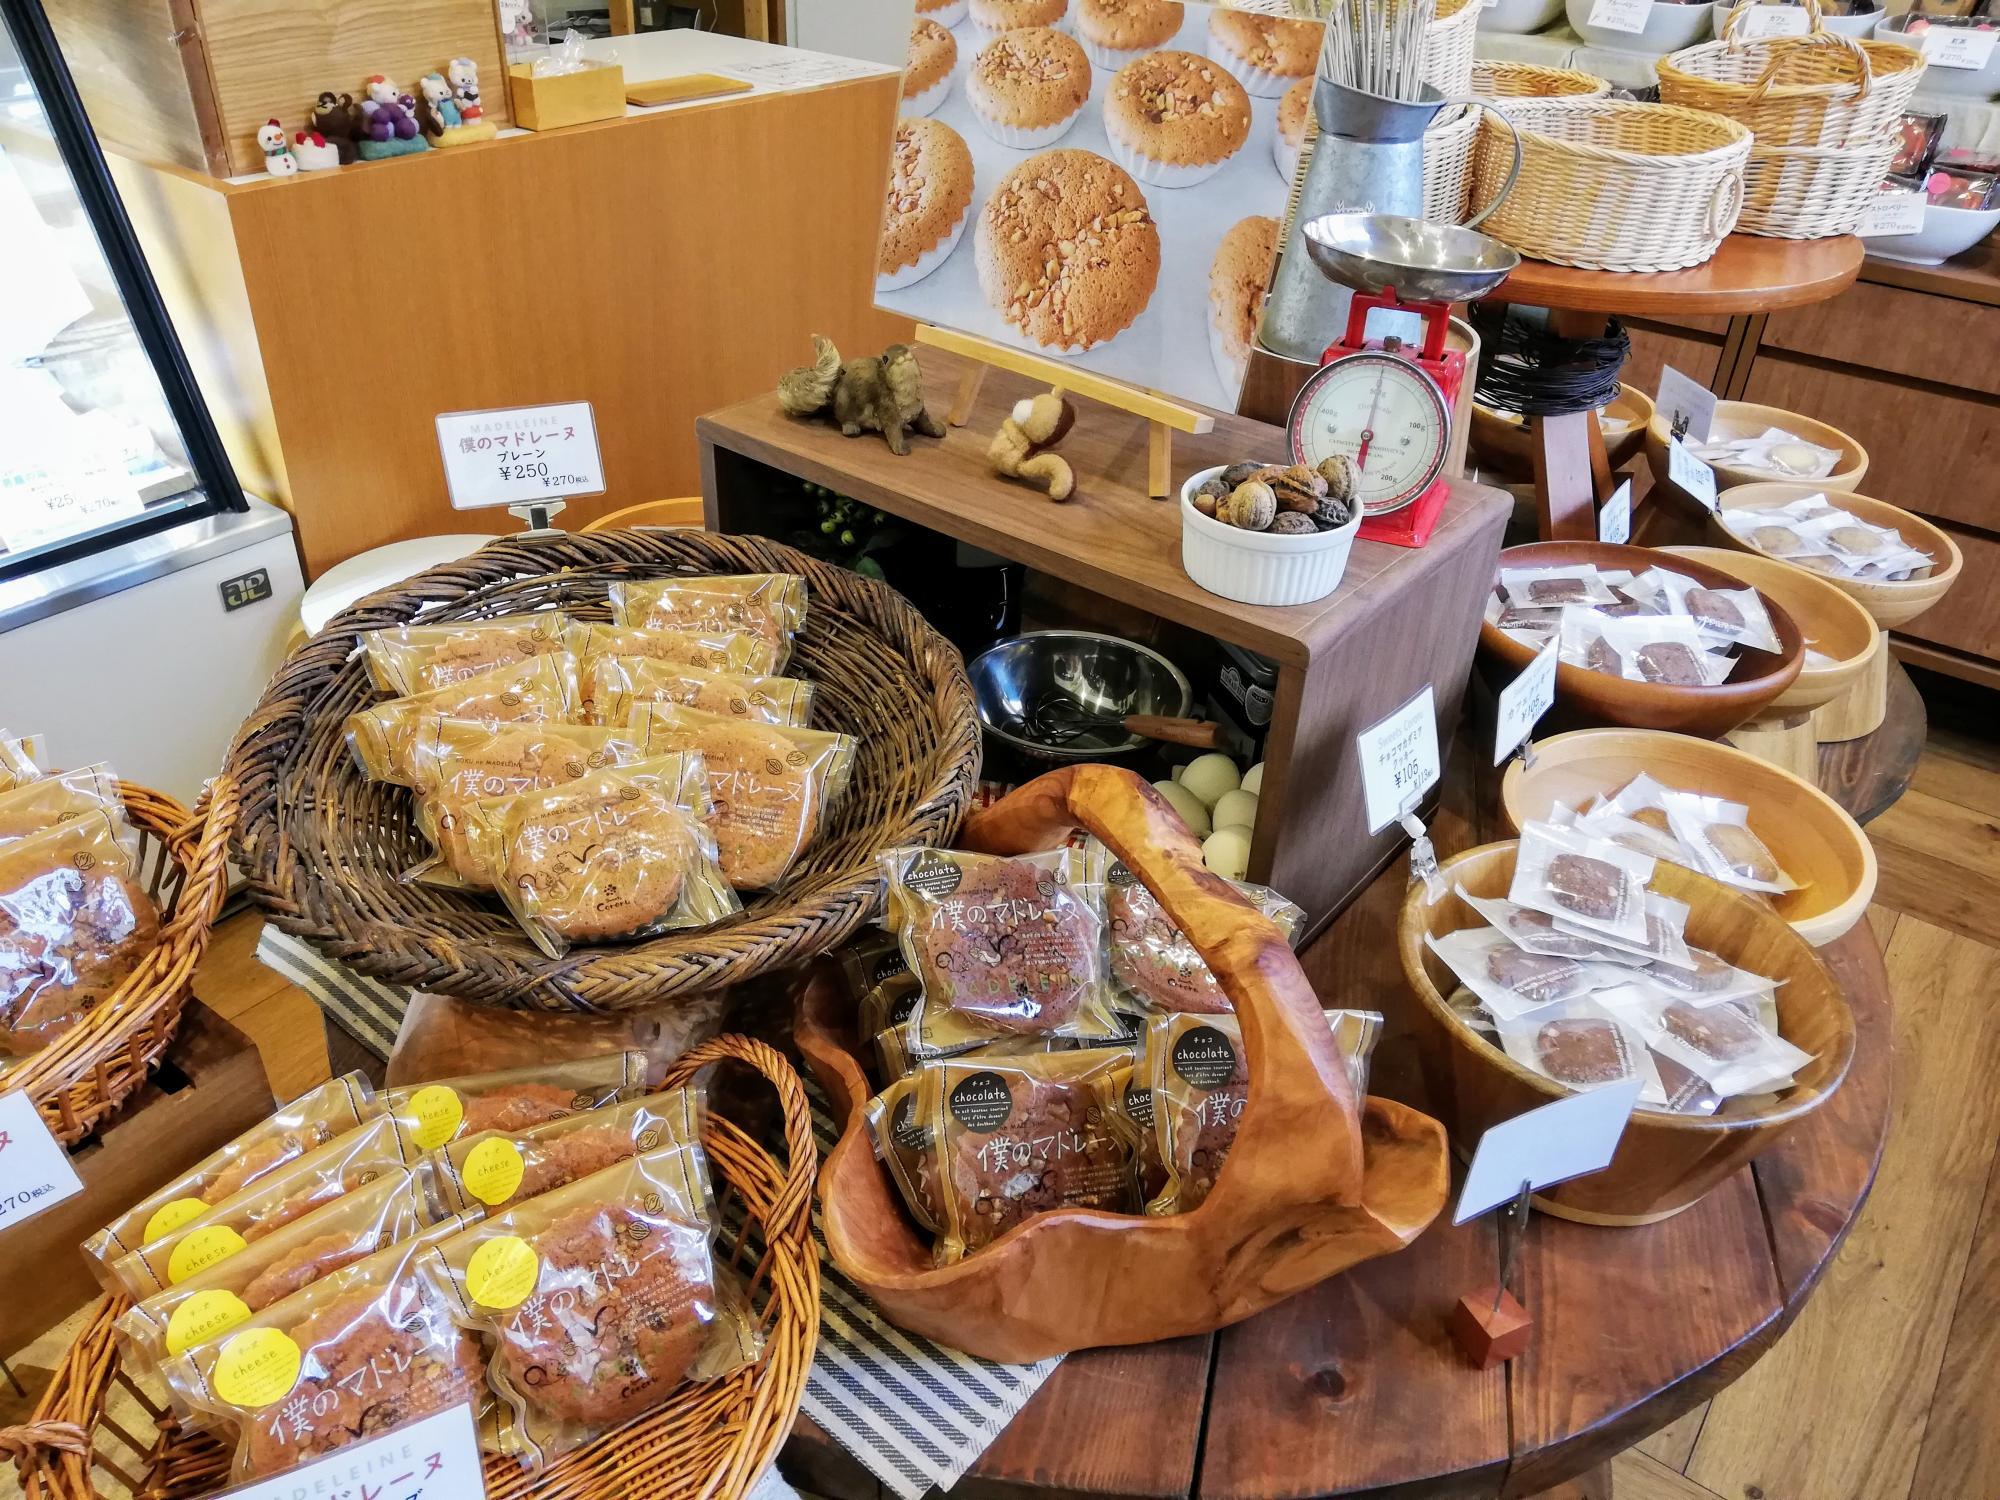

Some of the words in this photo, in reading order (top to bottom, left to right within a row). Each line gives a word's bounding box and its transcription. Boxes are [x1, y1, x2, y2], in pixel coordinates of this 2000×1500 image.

[470, 415, 559, 434] MADELEINE
[459, 427, 576, 454] 僕のマドレーヌ
[499, 462, 549, 481] ¥250
[1394, 758, 1419, 788] ¥105
[515, 797, 671, 862] 僕のマドレーヌ
[907, 864, 957, 881] chocolate
[931, 897, 1080, 931] 僕のマドレーヌ
[1177, 1045, 1231, 1061] chocolate
[954, 1087, 1007, 1103] chocolate
[477, 1159, 511, 1177] cheese
[185, 1244, 228, 1273] cheese
[184, 1310, 230, 1341] cheese
[232, 1347, 278, 1380] cheese
[269, 1341, 436, 1446] 僕のマドレー
[274, 1444, 413, 1500] DELEINE
